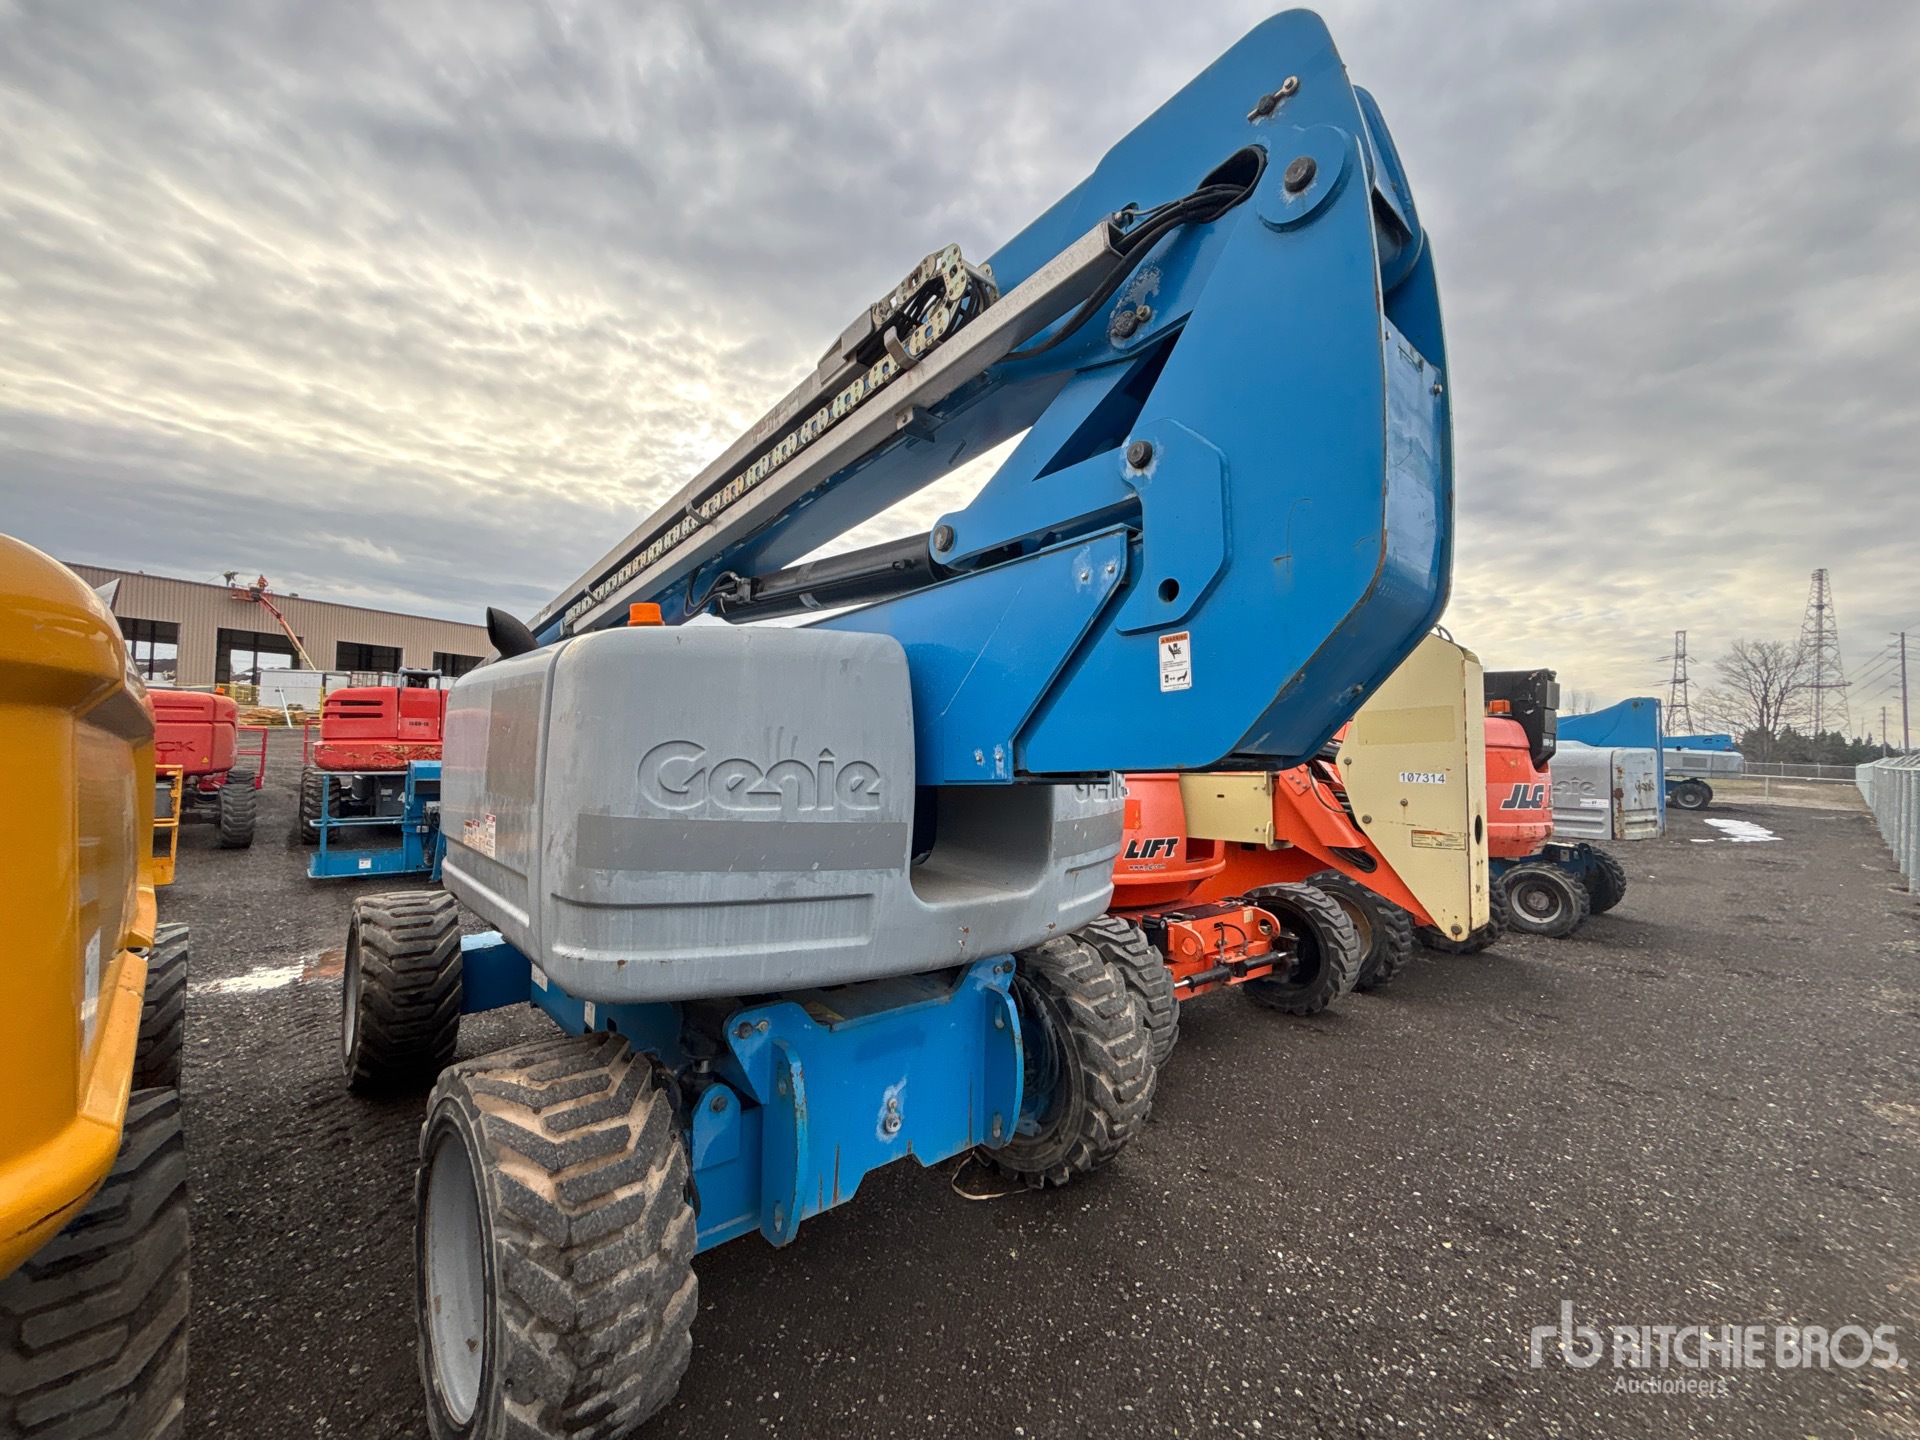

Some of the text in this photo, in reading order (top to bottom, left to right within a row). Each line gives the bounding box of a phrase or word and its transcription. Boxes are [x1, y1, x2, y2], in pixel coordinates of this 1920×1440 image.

[637, 740, 880, 810] Genie
[1401, 772, 1446, 783] 107314
[1500, 783, 1546, 810] JLG
[1124, 837, 1180, 860] LIFT
